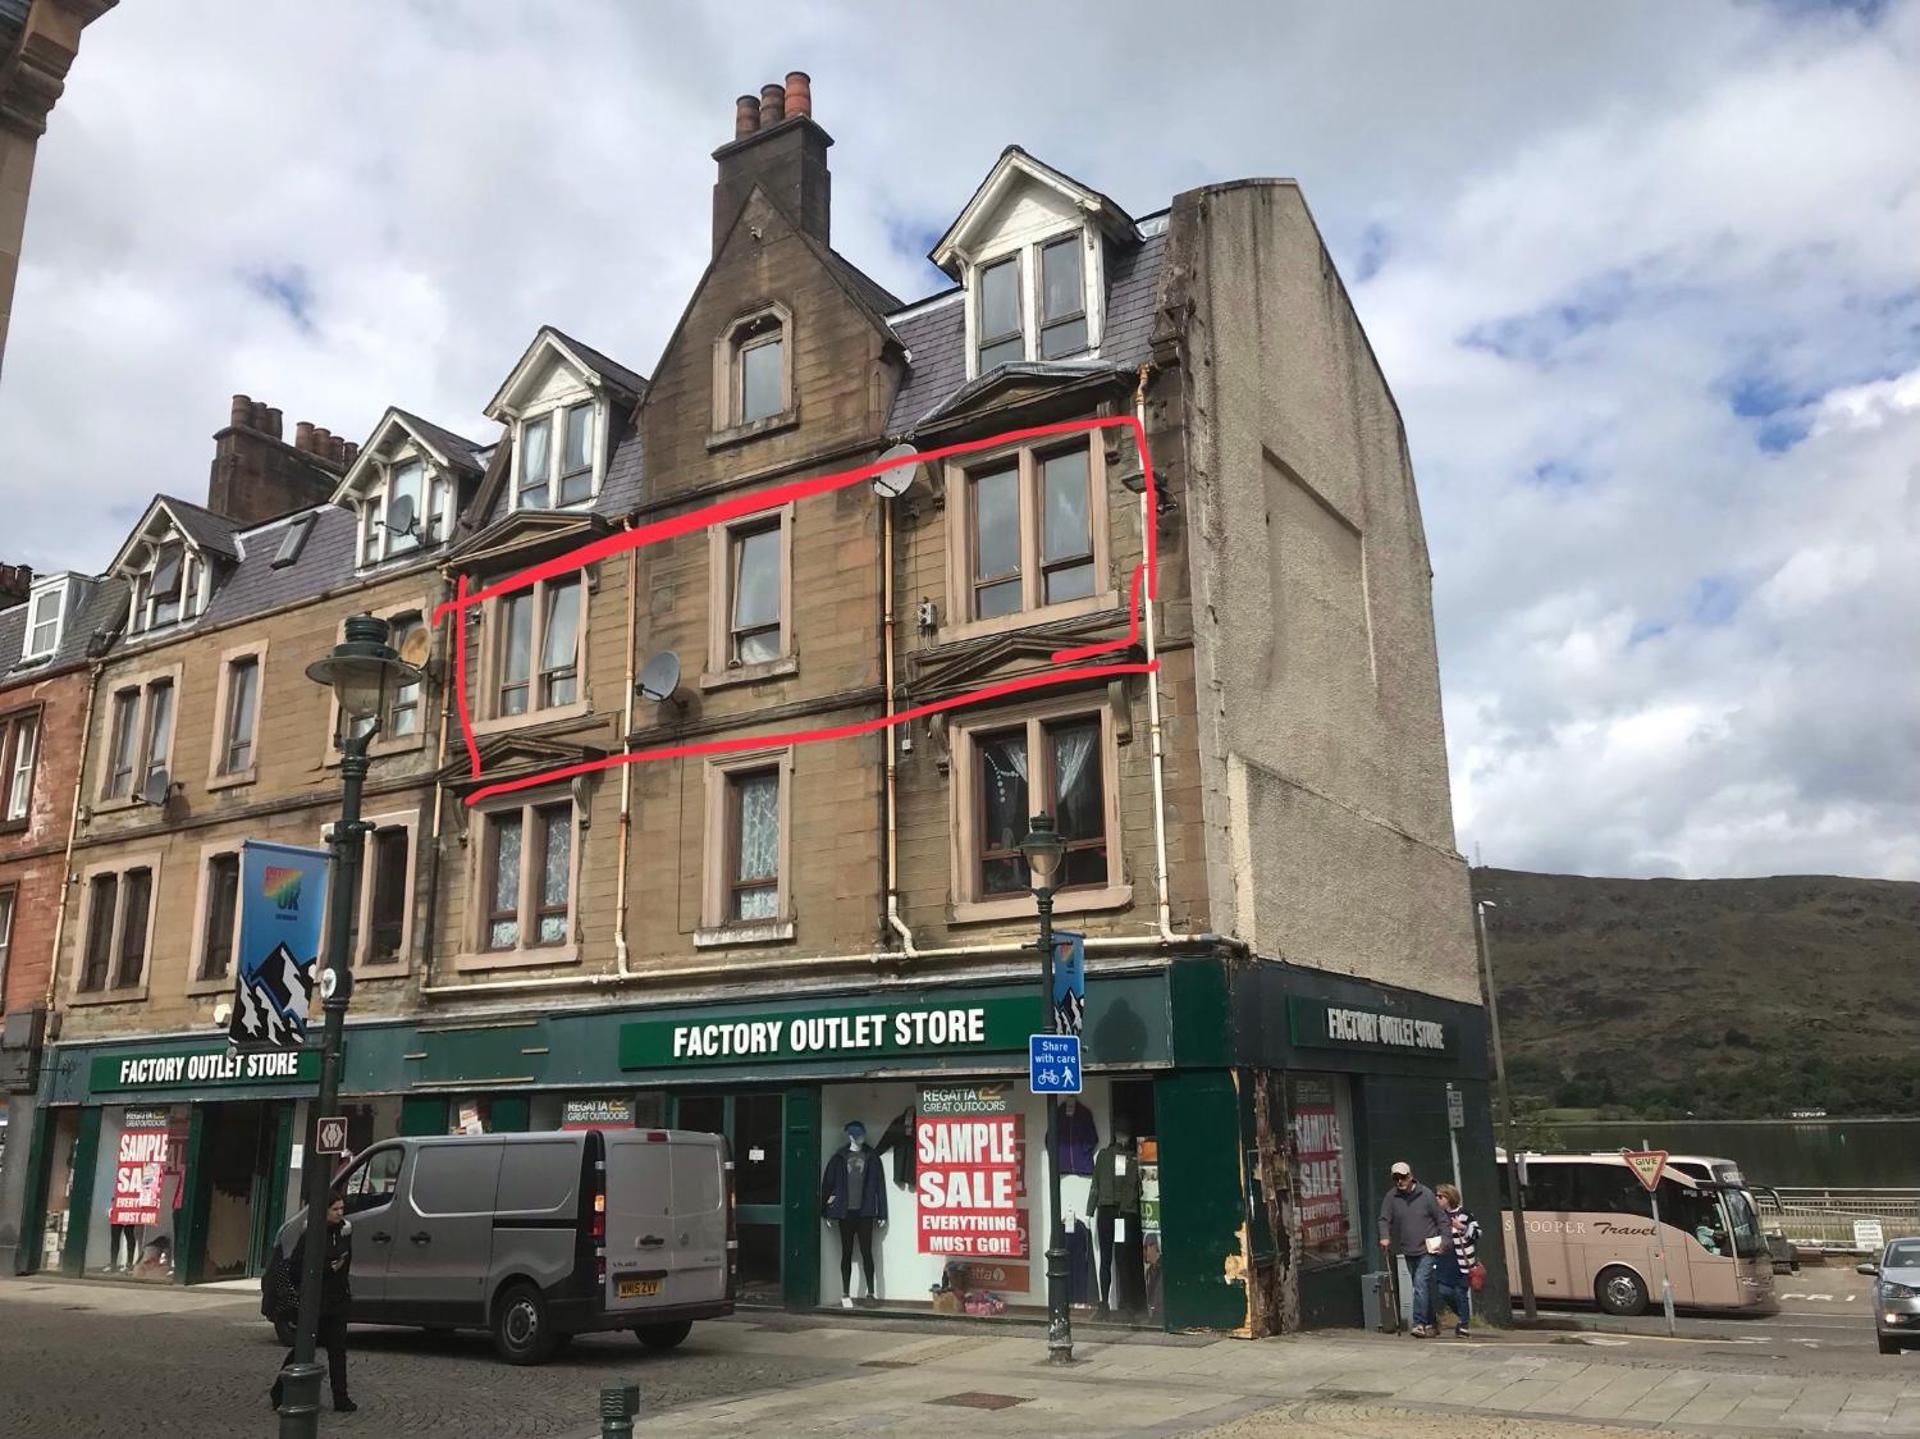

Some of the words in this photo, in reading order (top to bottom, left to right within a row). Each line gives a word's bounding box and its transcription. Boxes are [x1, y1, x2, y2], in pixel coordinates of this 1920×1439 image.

[673, 1021, 783, 1057] FACTORY
[790, 1014, 887, 1051] OUTLET
[895, 1008, 985, 1045] STORE
[1327, 1008, 1378, 1042] FACTORY
[1378, 1014, 1415, 1046] OUTLET
[1414, 1020, 1445, 1049] STORE
[1042, 1040, 1068, 1051] Share
[120, 1056, 185, 1083] FACTORY
[187, 1054, 244, 1080] OUTLET
[247, 1052, 299, 1077] STORE
[1034, 1053, 1054, 1064] with
[1056, 1054, 1076, 1064] care
[923, 1088, 977, 1101] REGATTA
[567, 1111, 589, 1121] GREAT
[589, 1111, 629, 1120] OUTDOORS
[923, 1101, 952, 1112] GREAT
[953, 1100, 1006, 1112] OUTDOORS
[918, 1122, 1015, 1164] SAMPLE
[1296, 1114, 1338, 1153] SAMPLE
[120, 1134, 168, 1162] SAMPLE
[1635, 1158, 1657, 1166] GIVE
[117, 1167, 160, 1193] SA
[919, 1171, 1014, 1209] SALE
[1300, 1160, 1338, 1199] SALE
[922, 1215, 1017, 1231] EVERYTHING
[1593, 1222, 1657, 1236] Travel
[929, 1236, 973, 1252] MUST
[977, 1237, 1011, 1253] GO!!
